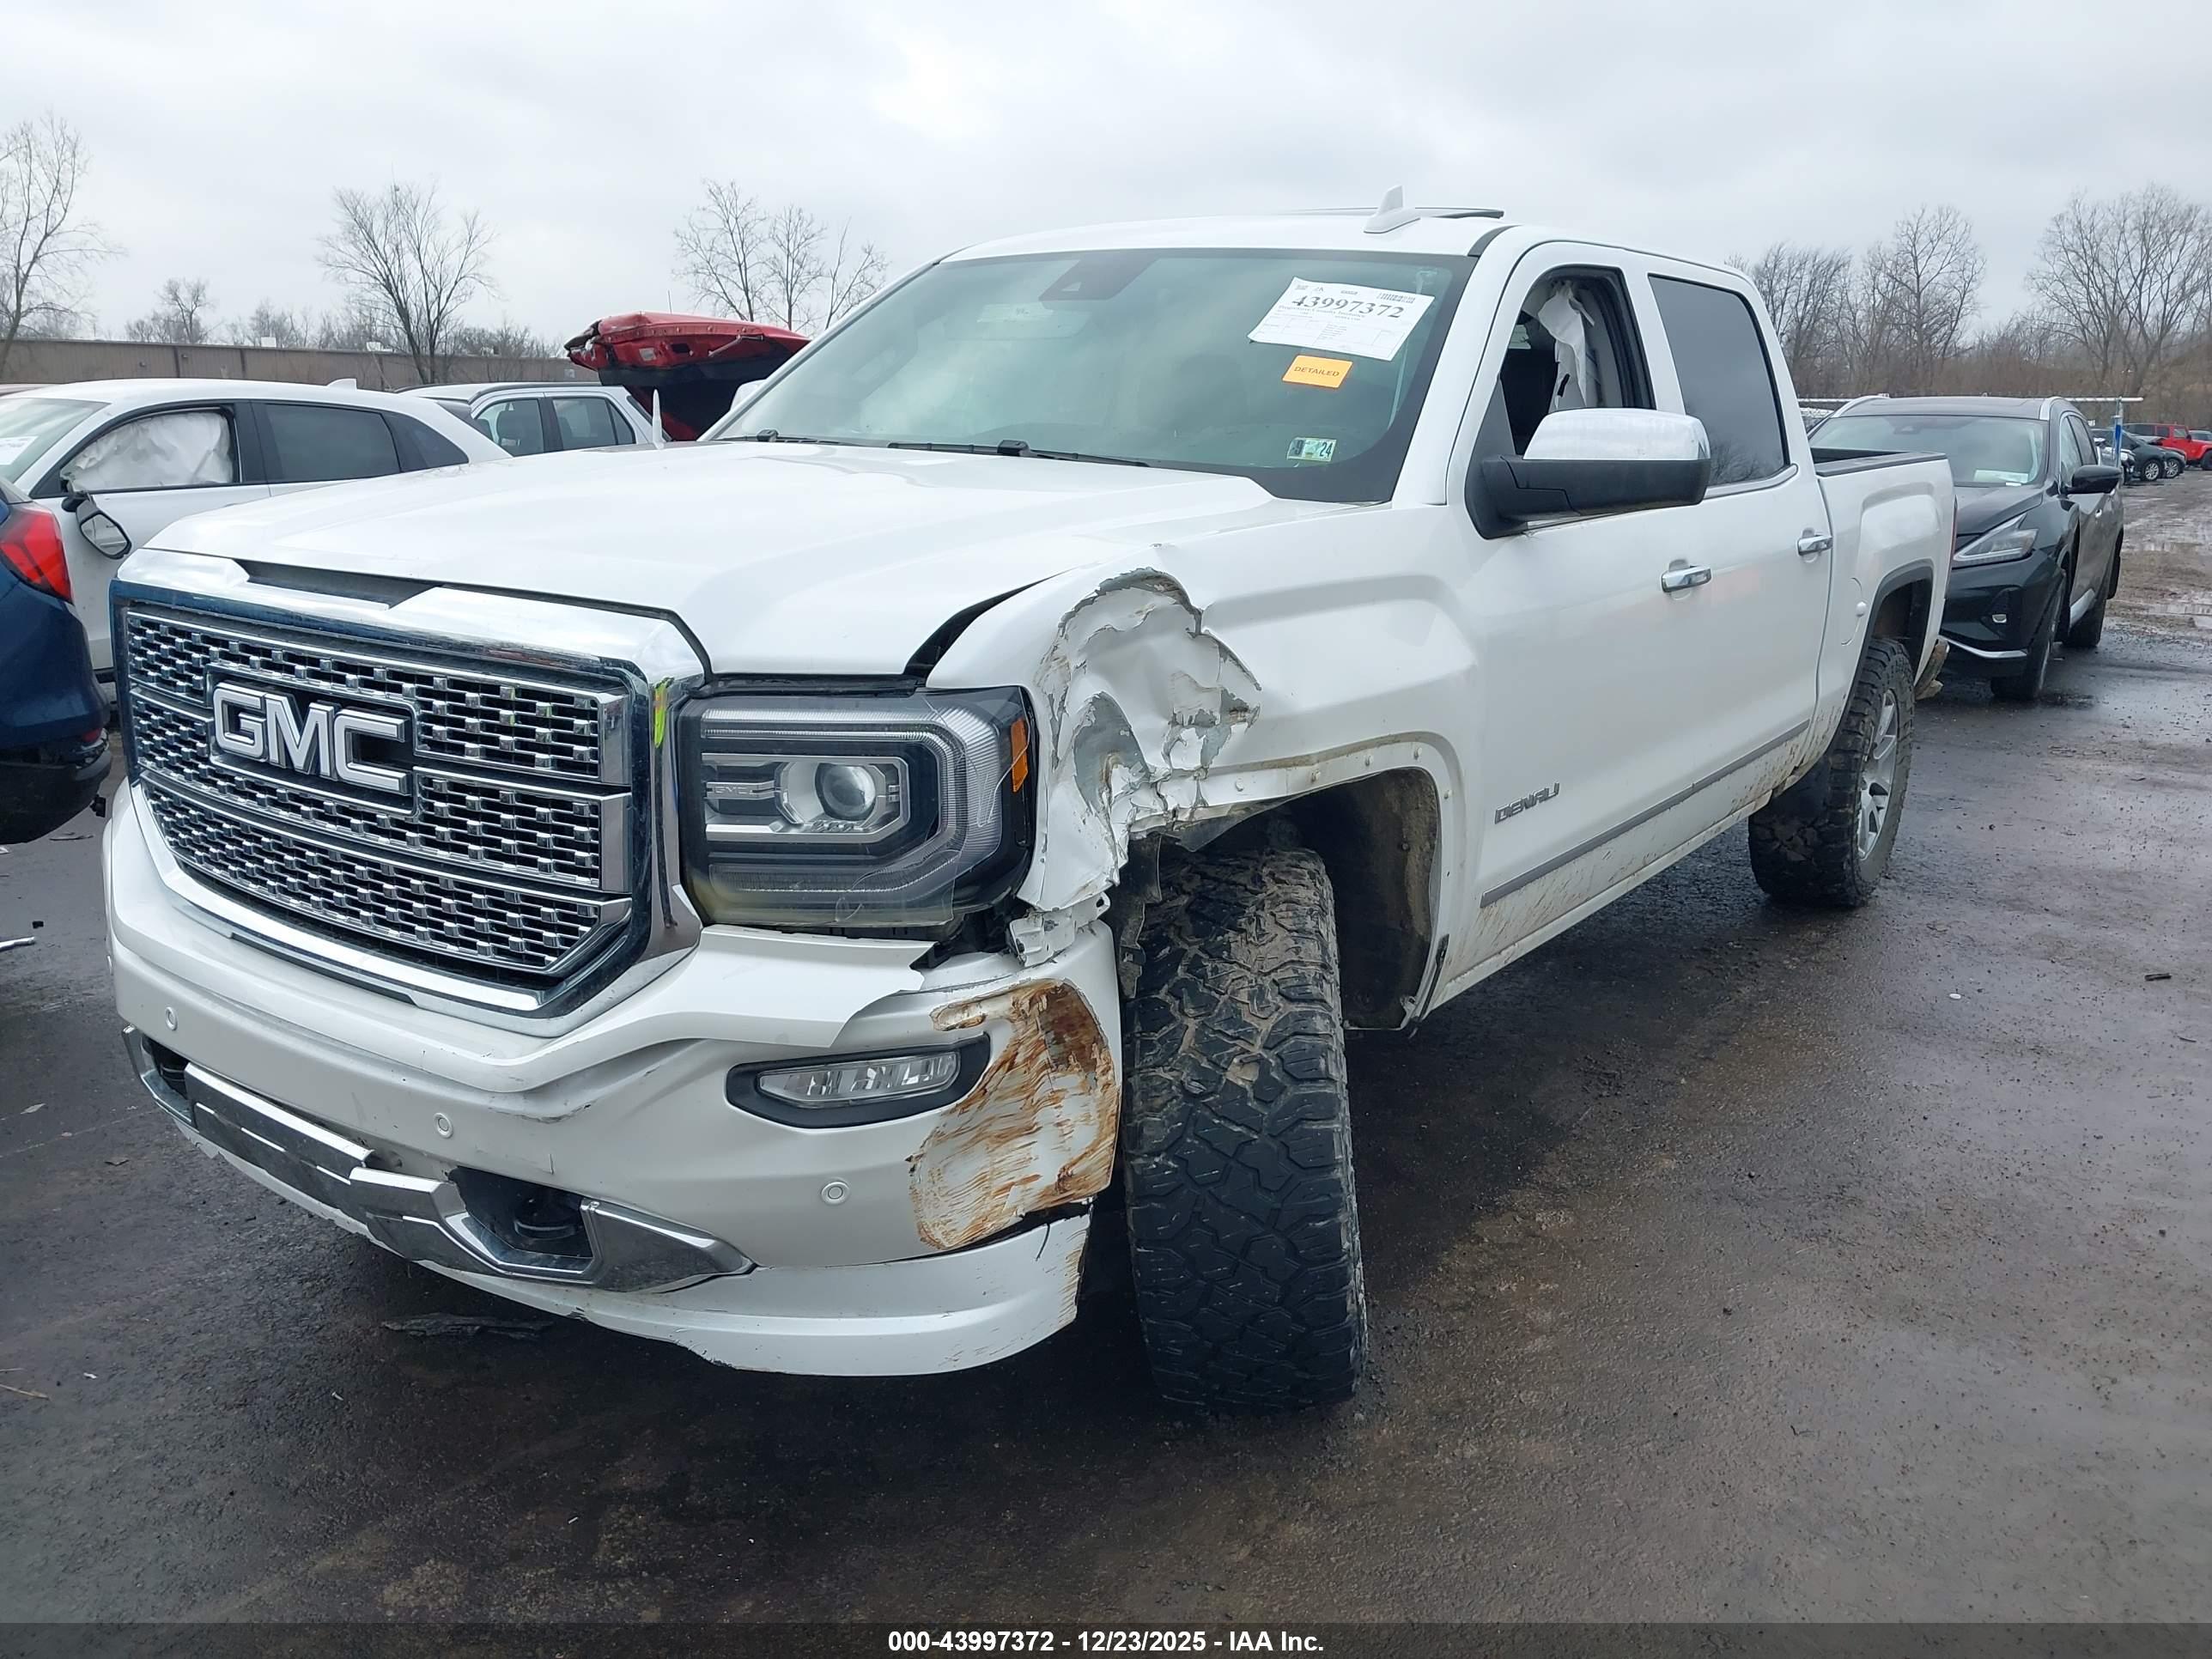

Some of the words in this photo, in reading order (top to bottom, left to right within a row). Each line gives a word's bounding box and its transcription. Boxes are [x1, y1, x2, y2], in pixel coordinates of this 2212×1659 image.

[1291, 295, 1405, 319] 43997372
[1294, 366, 1340, 377] DETAILED
[1319, 441, 1334, 458] 24
[213, 681, 410, 796] GMC
[1494, 782, 1560, 824] DENALI
